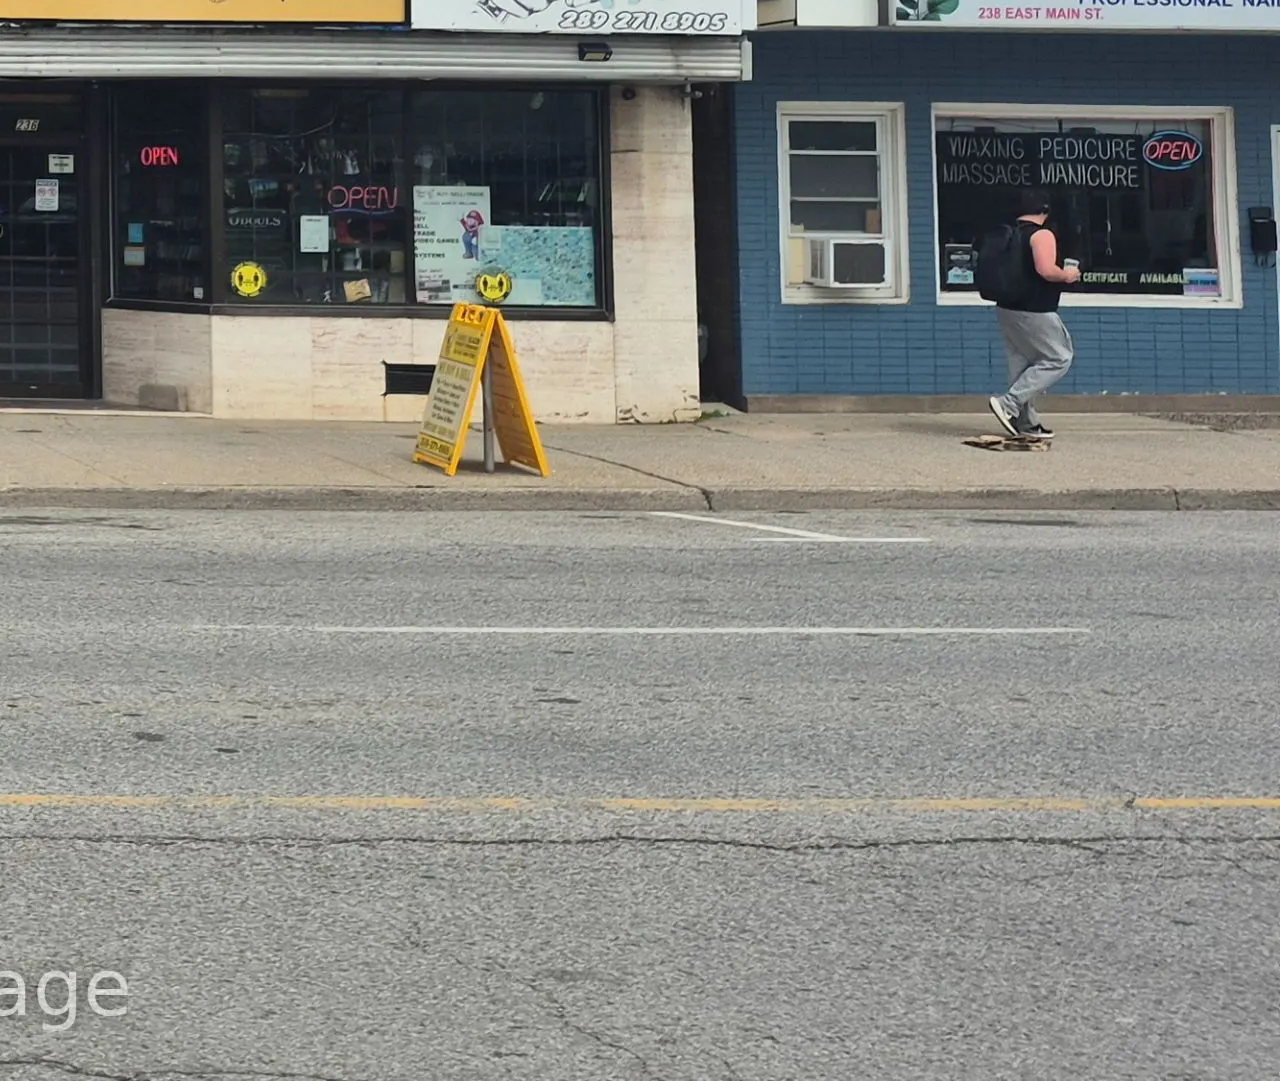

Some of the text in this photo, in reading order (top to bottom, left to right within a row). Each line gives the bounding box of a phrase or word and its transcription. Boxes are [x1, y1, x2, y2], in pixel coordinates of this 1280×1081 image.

[558, 11, 728, 32] 289 271 8905
[978, 7, 1104, 20] 238 EAST MAIN ST.
[16, 119, 40, 131] 236
[140, 146, 179, 166] OPEN
[948, 136, 1136, 160] WAXING PEDICURE
[1145, 141, 1197, 161] OPEN
[943, 163, 1139, 188] MASSAGE MANICURE
[328, 185, 397, 209] OPEN
[1083, 272, 1128, 284] CERTIFICATE
[1139, 273, 1188, 284] AVAILABL
